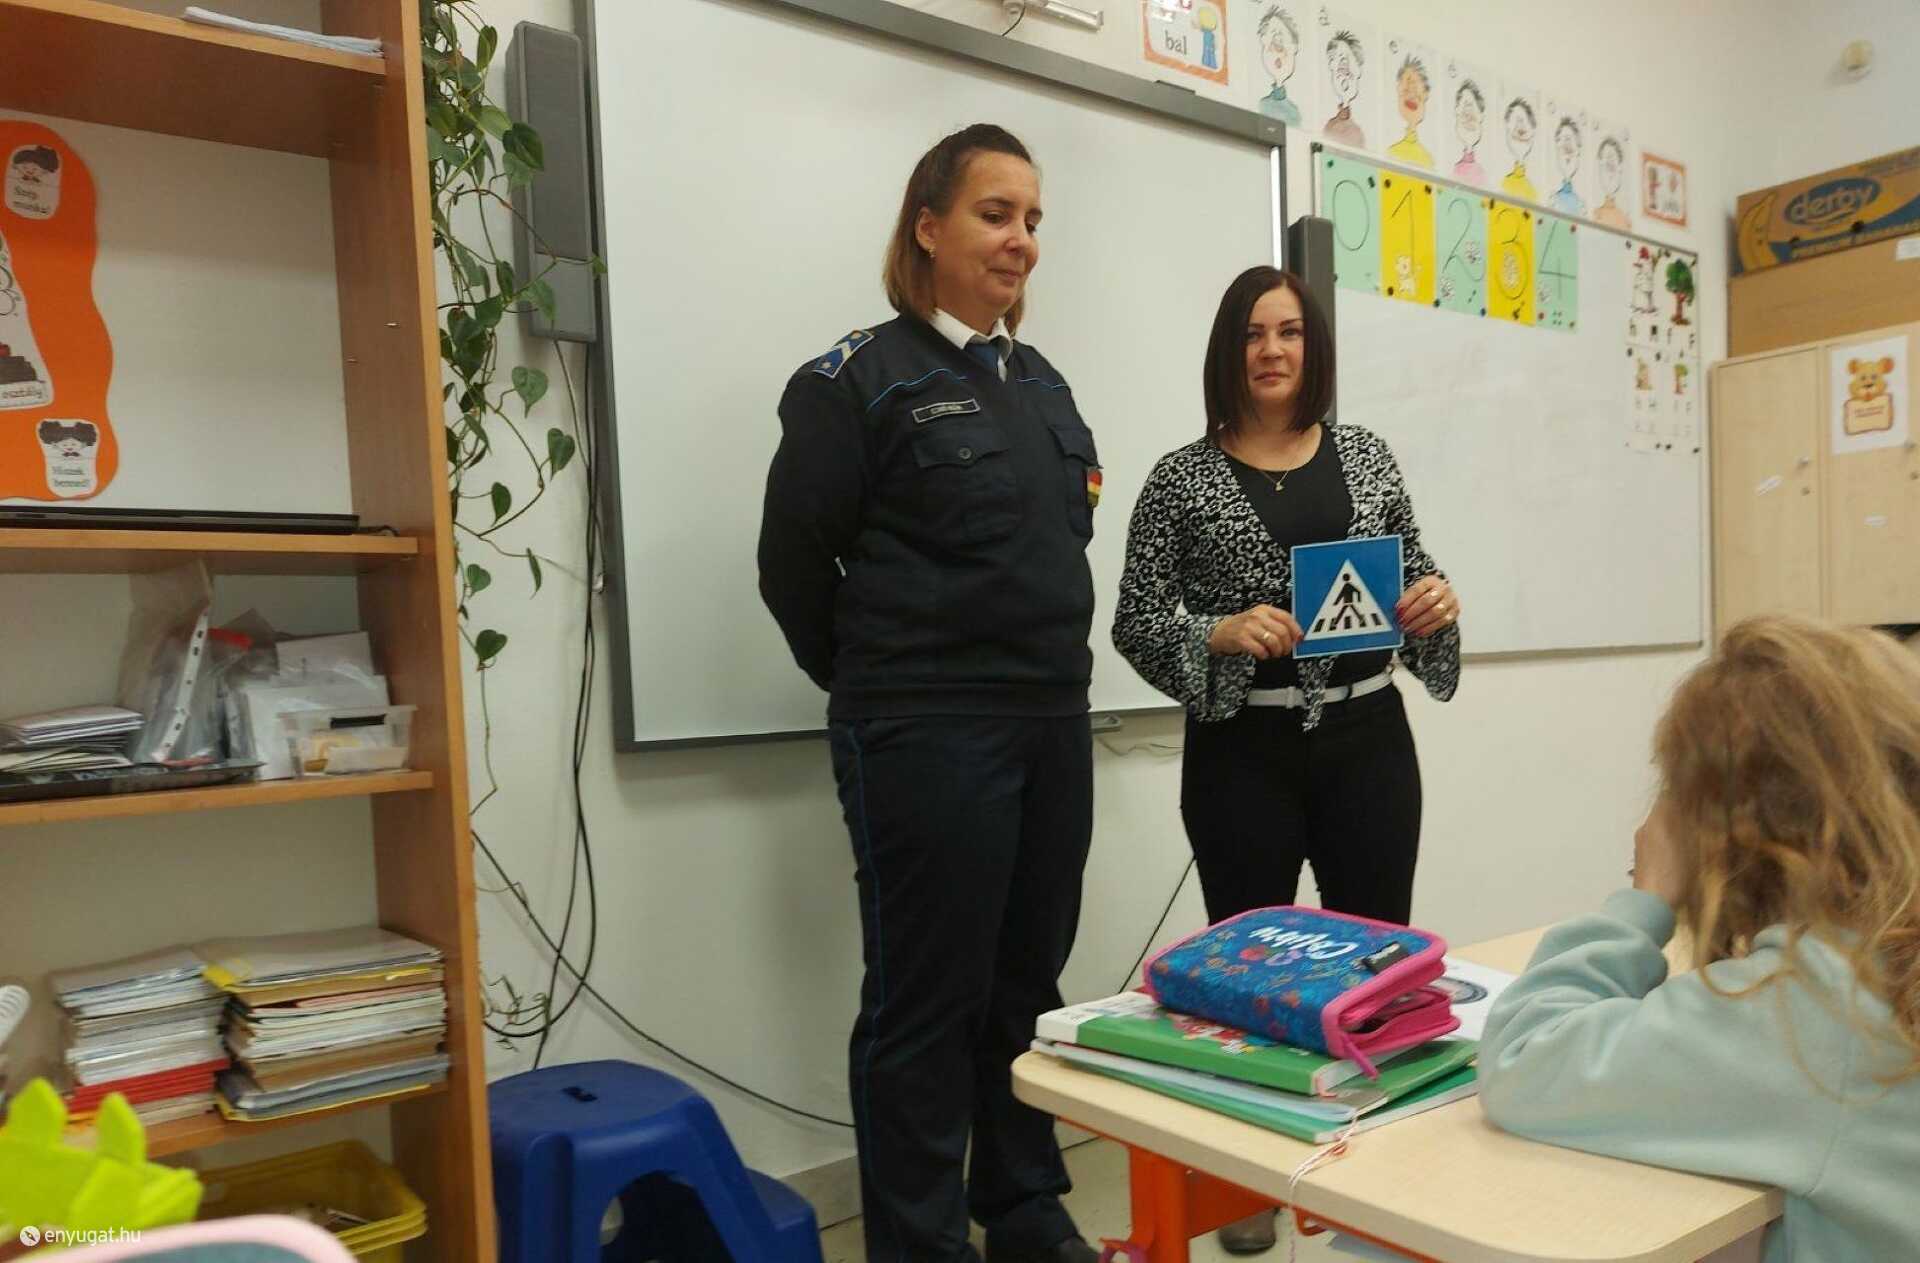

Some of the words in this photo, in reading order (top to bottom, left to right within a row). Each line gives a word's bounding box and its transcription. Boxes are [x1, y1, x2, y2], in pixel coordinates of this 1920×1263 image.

[1164, 29, 1188, 56] bal
[1788, 184, 1875, 220] derby
[1332, 179, 1370, 251] 0
[1391, 189, 1415, 278] 1
[1441, 198, 1485, 282] 2
[1496, 207, 1530, 301] 3
[1538, 220, 1577, 300] 4
